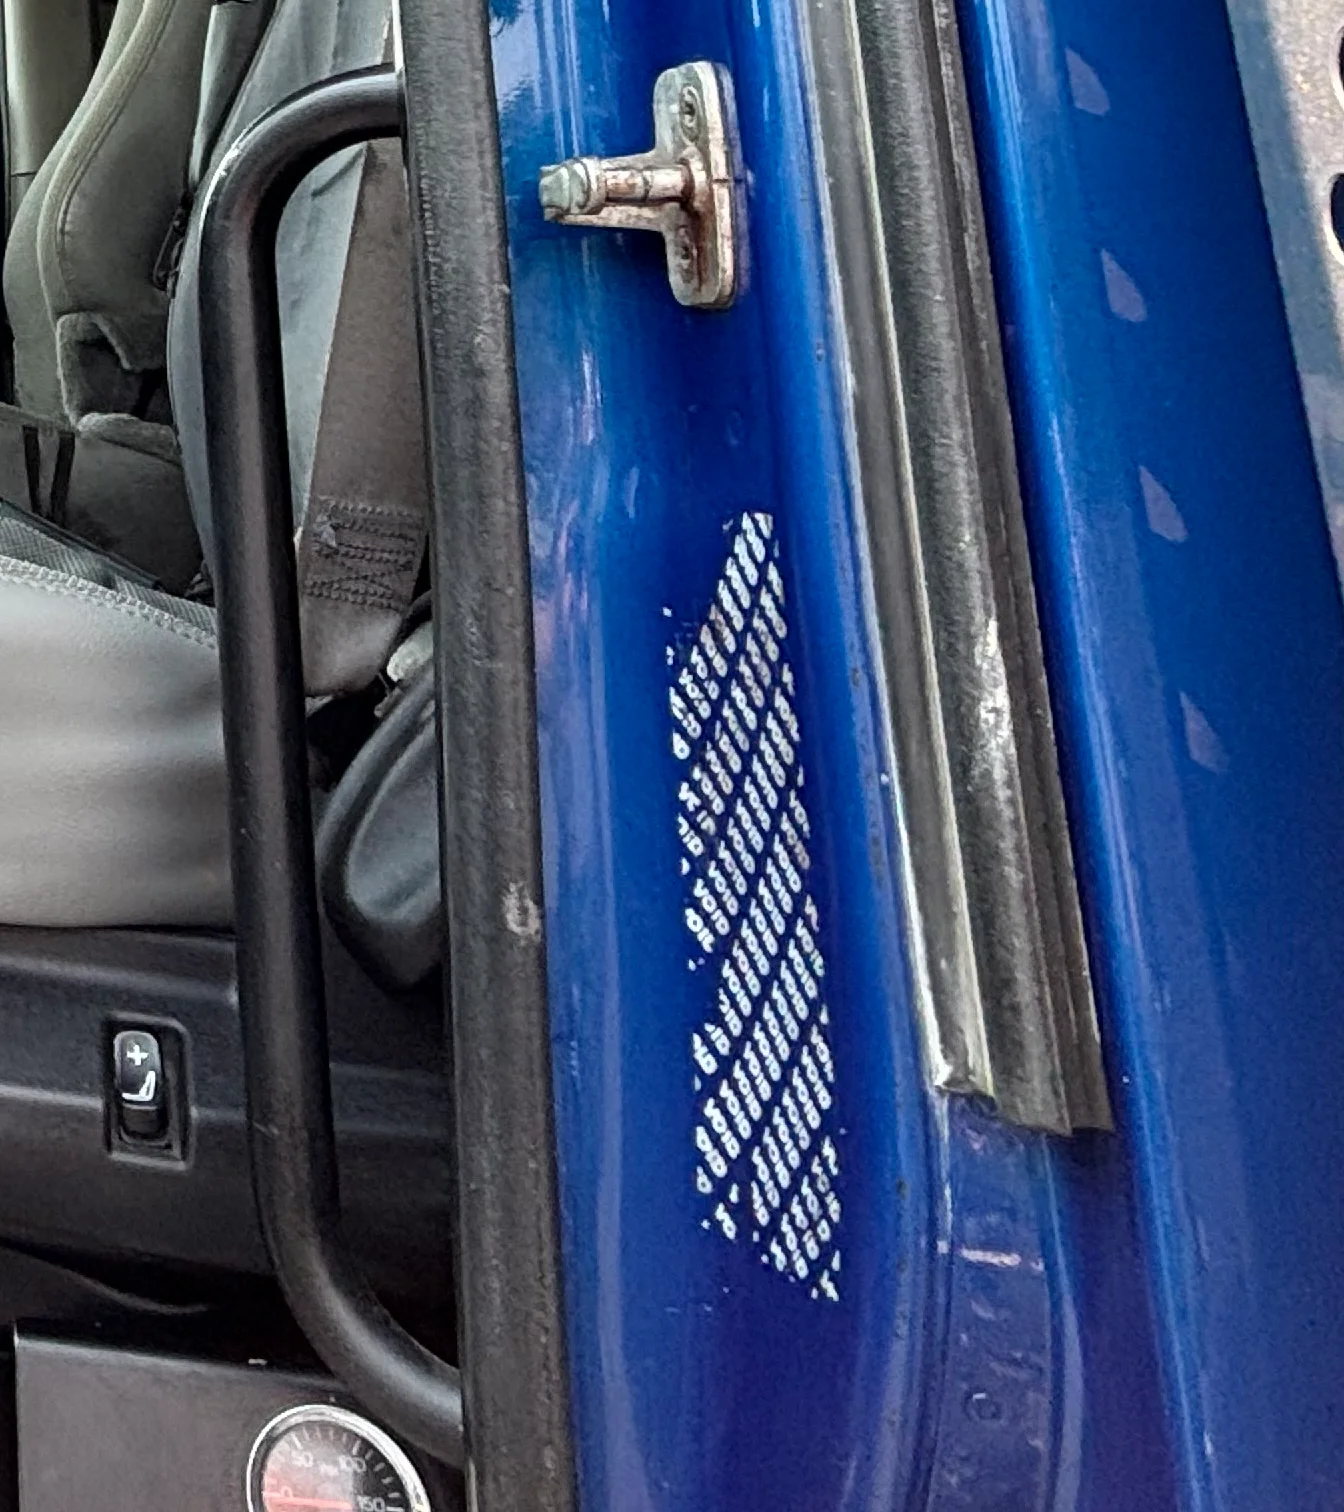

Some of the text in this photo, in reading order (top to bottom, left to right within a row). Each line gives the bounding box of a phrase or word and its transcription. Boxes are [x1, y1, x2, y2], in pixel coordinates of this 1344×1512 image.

[752, 755, 778, 809] VOID
[760, 732, 785, 787] VOID
[766, 712, 793, 764] VOID
[706, 742, 733, 794] VOID
[736, 799, 763, 853] VOID
[766, 858, 792, 913] VOID
[744, 776, 770, 831] VOID
[774, 834, 801, 892] VOID
[718, 840, 746, 894] VOID
[750, 899, 777, 955] VOID
[780, 960, 808, 1020] VOID
[727, 818, 755, 874] VOID
[758, 878, 785, 934] VOID
[788, 939, 817, 998] VOID
[694, 879, 820, 1129] VOID VOID VOID VOID
[708, 861, 738, 915] VOID
[741, 919, 769, 975] VOID
[772, 981, 799, 1040] VOID
[801, 1046, 831, 1109] VOID
[722, 959, 751, 1016] VOID
[753, 1022, 781, 1081] VOID
[782, 1088, 810, 1149] VOID
[704, 1098, 740, 1159] VOID
[719, 1080, 751, 1139] VOID
[752, 1146, 780, 1207] VOID
[781, 1213, 808, 1278] VOID
[733, 1060, 762, 1121] VOID
[763, 1127, 790, 1188] VOID
[743, 1041, 771, 1101] VOID
[773, 1106, 800, 1169] VOID
